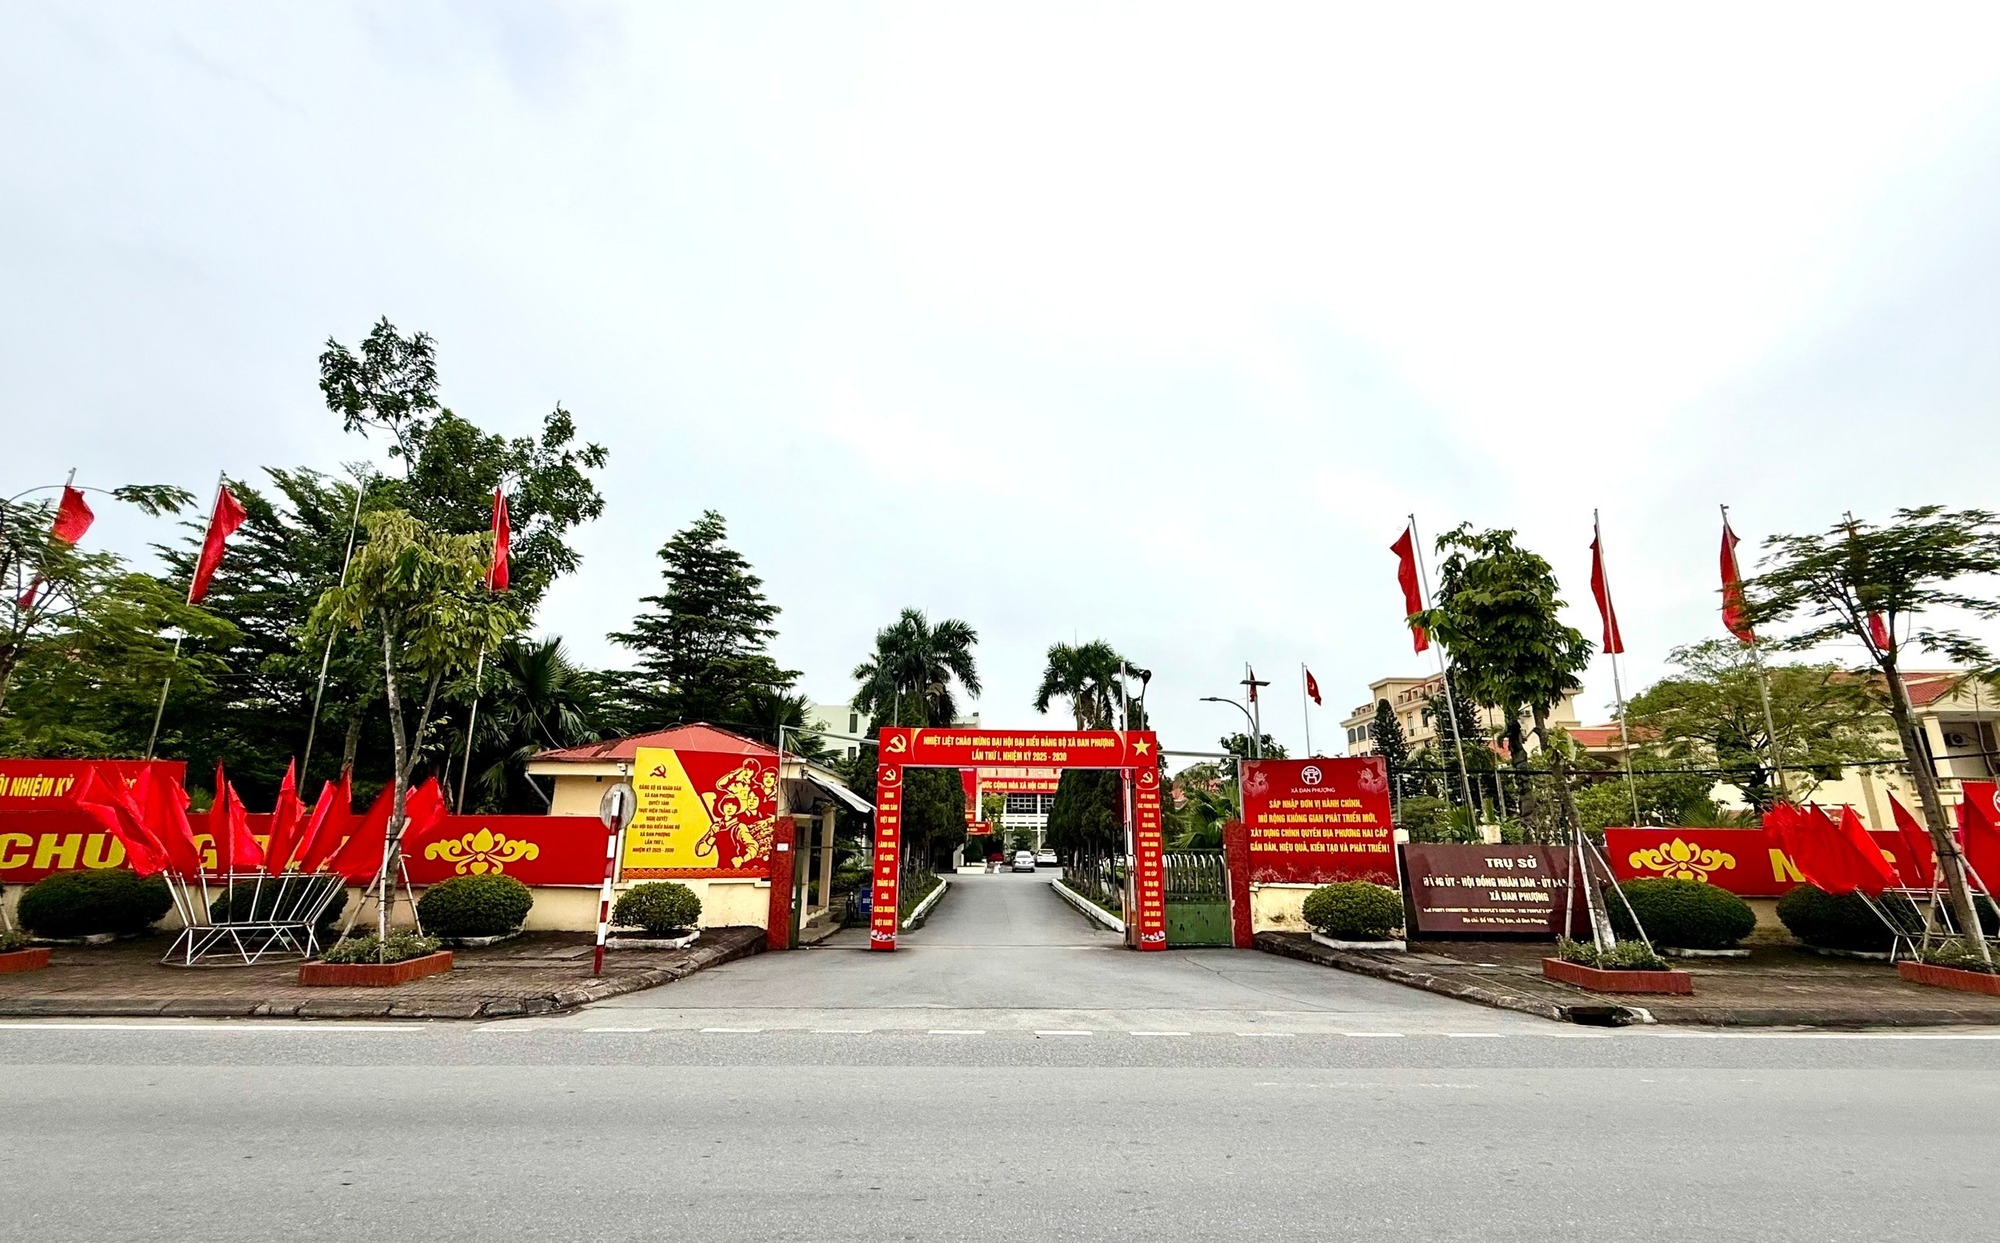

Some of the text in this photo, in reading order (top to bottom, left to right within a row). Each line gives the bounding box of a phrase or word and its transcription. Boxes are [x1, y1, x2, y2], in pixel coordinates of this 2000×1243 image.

[924, 735, 1115, 749] NHIỆT LIỆT CHÀO MỪNG ĐẠI HỘI ĐẠI BIỂU ĐẢNG BỘ XÃ ĐAN PHƯỢNG
[972, 748, 984, 760] LẦN
[985, 750, 997, 760] THỨ
[998, 751, 1001, 761] I,
[1003, 750, 1022, 762] NHIỆM
[1023, 750, 1031, 761] KỲ
[1033, 752, 1047, 761] 2025
[1052, 752, 1067, 761] 2030
[9, 774, 54, 800] NHIỆM
[1269, 798, 1363, 810] SÁP NHẬP ĐƠN VỊ HÀNH CHÍNH,
[1258, 811, 1377, 824] MỞ RỘNG KHÔNG GIAN PHÁT TRIỂN MỚI,
[1251, 826, 1388, 839] XÂY DỰNG CHÍNH QUYỀN ĐỊA PHƯƠNG HAI CẤP
[1250, 841, 1263, 851] GẦN
[1263, 841, 1278, 852] DÂN,
[1279, 841, 1293, 854] HIỆU
[1294, 841, 1309, 852] QUẢ,
[1310, 841, 1325, 852] KIẾN
[1326, 844, 1338, 854] TẠO
[1340, 842, 1348, 852] VÀ
[1350, 842, 1366, 852] PHÁT
[1484, 855, 1537, 870] TRỤ SỞ
[1445, 874, 1455, 886] ỦY
[1461, 876, 1475, 888] HỘI
[1475, 874, 1497, 887] ĐỒNG
[1497, 876, 1519, 887] NHÂN
[1519, 876, 1536, 887] DÂN
[1541, 875, 1551, 888] ỦY
[1489, 890, 1549, 903] XÃ ĐAN PHƯỢNG
